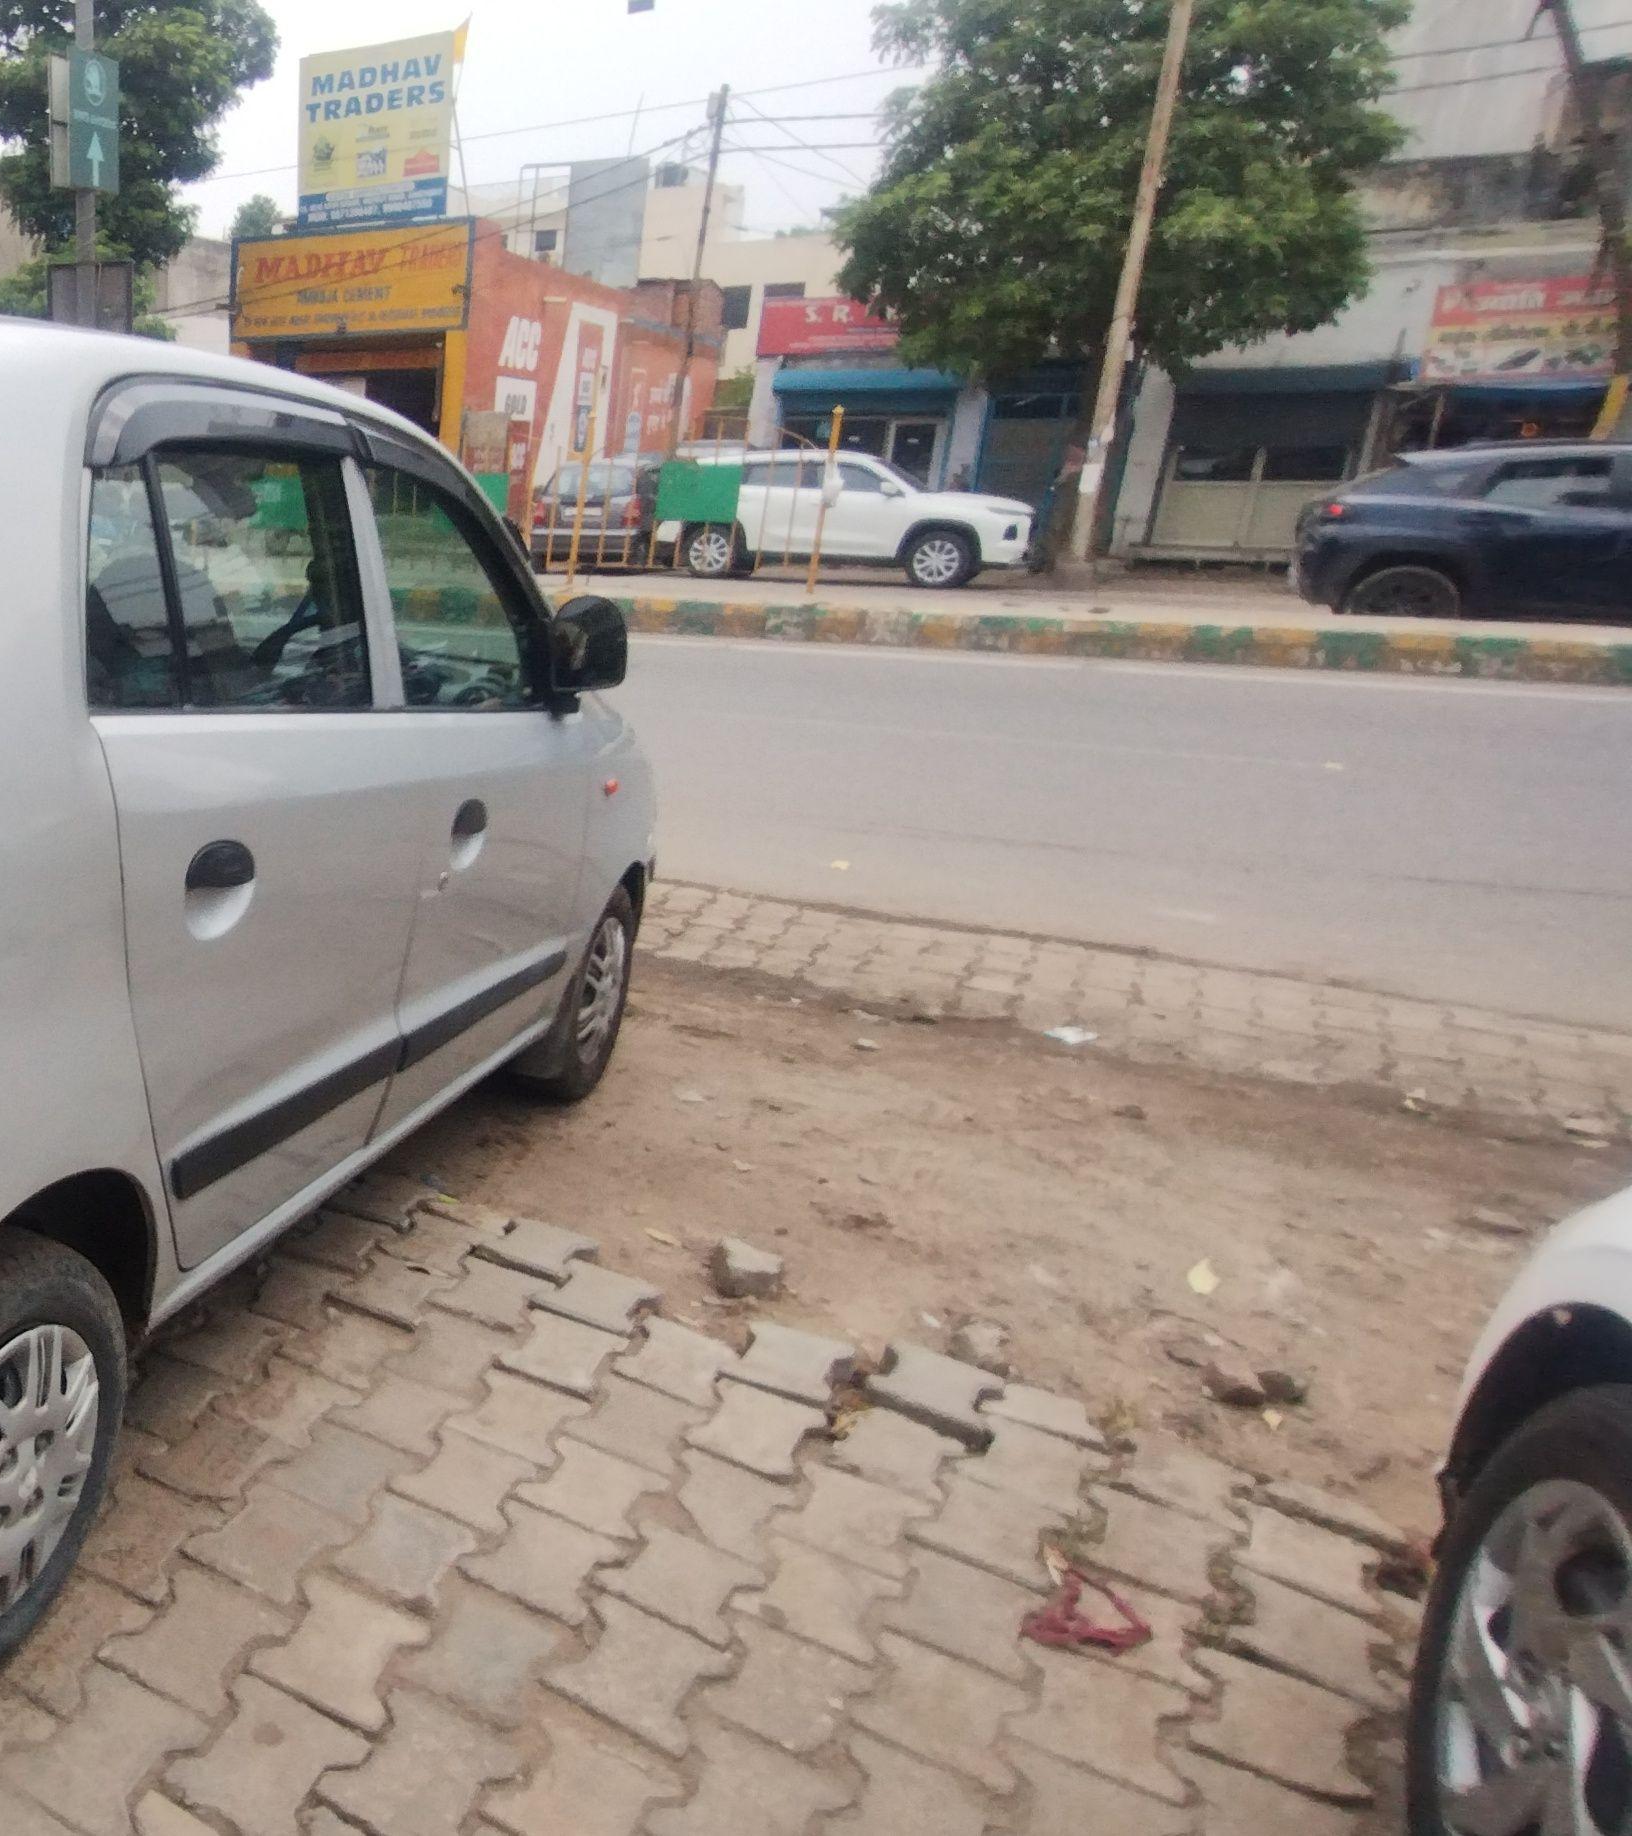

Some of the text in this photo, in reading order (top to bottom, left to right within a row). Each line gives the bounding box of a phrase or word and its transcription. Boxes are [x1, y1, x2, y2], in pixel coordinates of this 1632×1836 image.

[311, 54, 442, 96] MADHAV
[305, 81, 445, 123] TRADERS
[254, 248, 387, 283] MADHAV
[498, 316, 541, 371] ACC
